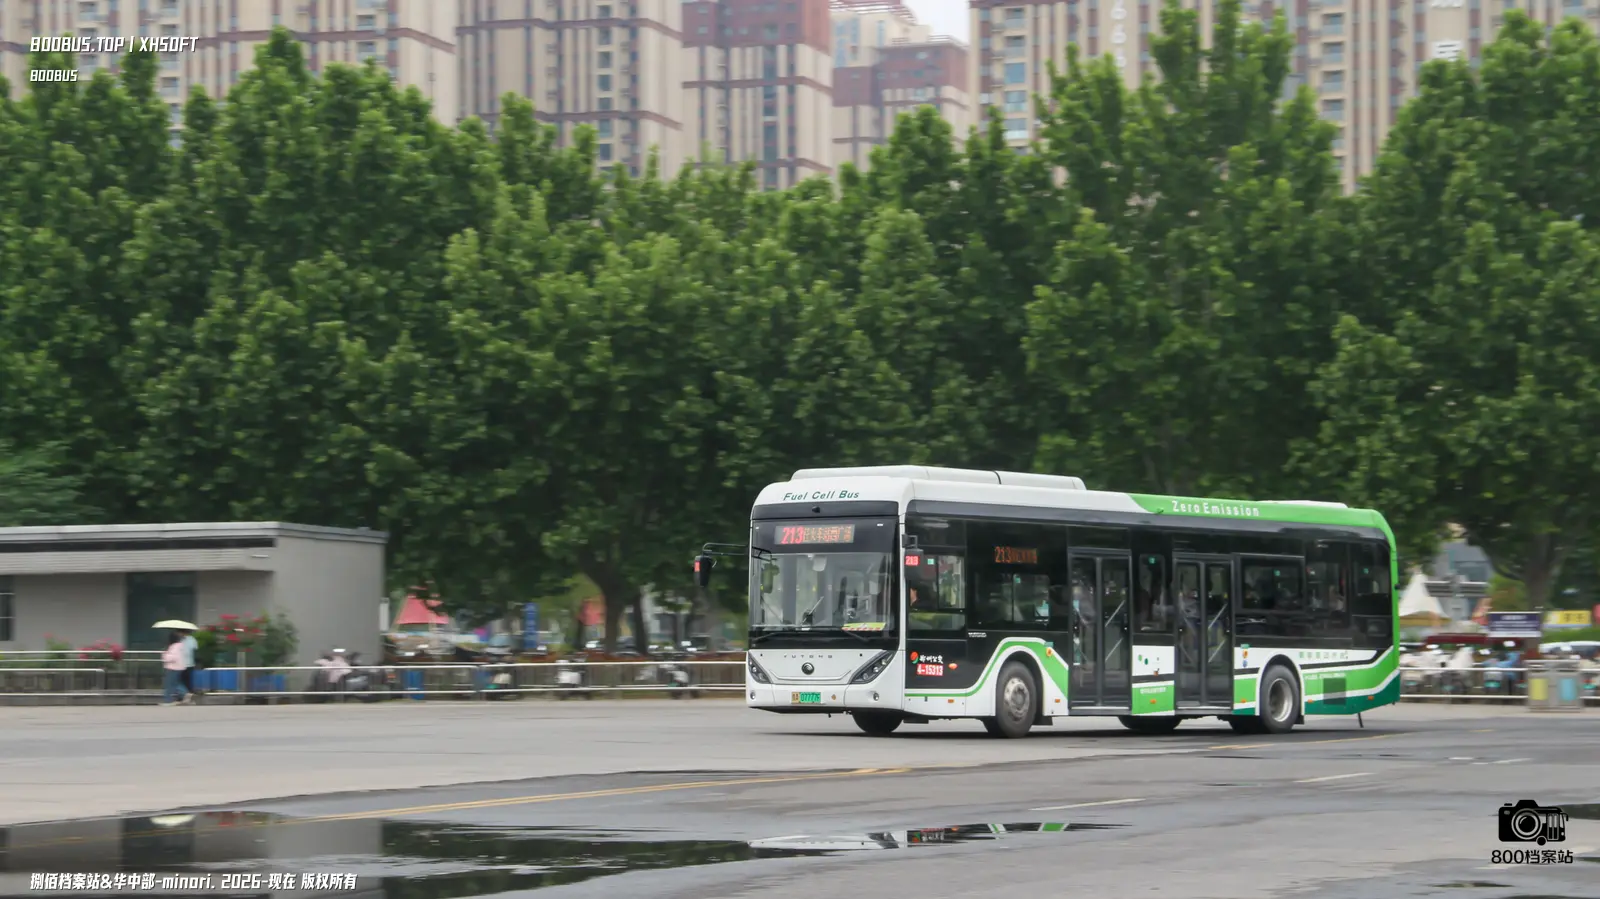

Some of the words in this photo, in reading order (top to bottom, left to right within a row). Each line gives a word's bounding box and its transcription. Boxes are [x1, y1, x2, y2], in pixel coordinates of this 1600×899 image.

[783, 492, 808, 501] Fuel
[812, 491, 835, 499] Cell
[839, 490, 860, 498] Bus
[1172, 500, 1200, 513] Zero
[1203, 502, 1260, 517] Emission
[781, 526, 804, 545] 213
[906, 556, 919, 565] 213
[995, 546, 1012, 563] 213
[917, 664, 943, 676] 4-15313
